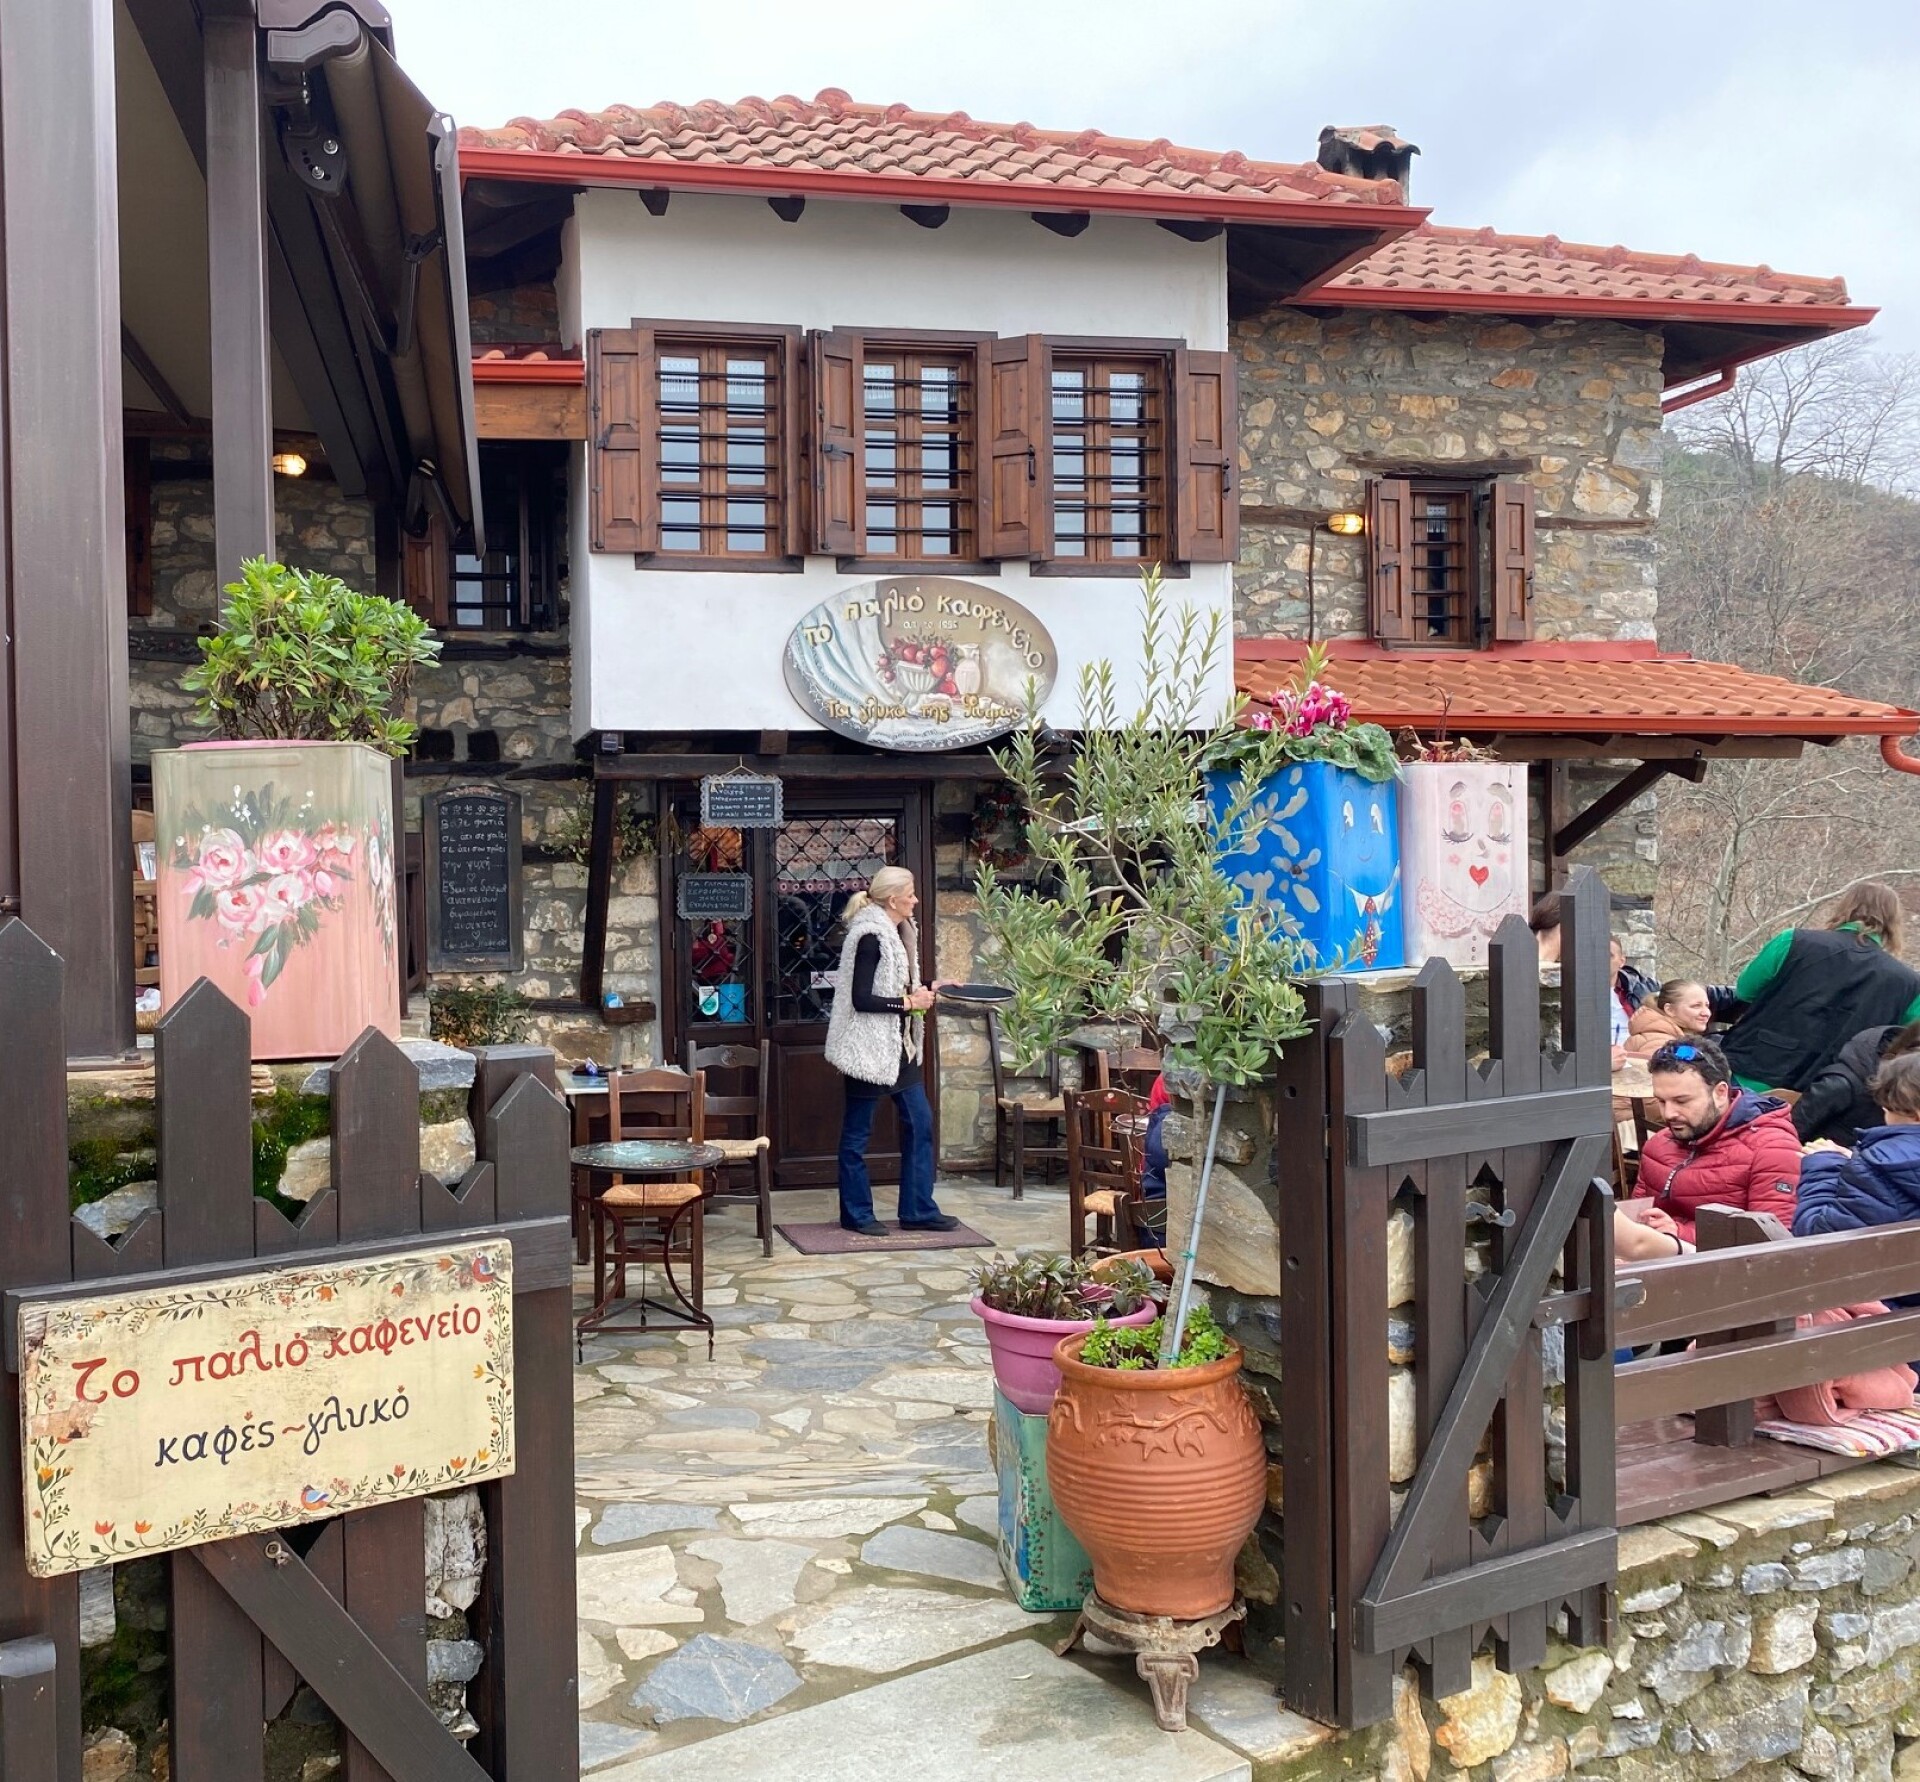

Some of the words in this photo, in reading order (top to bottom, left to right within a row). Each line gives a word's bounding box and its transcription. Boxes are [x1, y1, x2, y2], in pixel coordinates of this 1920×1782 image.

[71, 1357, 140, 1404] Το
[169, 1330, 309, 1386] παλιό
[323, 1303, 482, 1361] καφενείο
